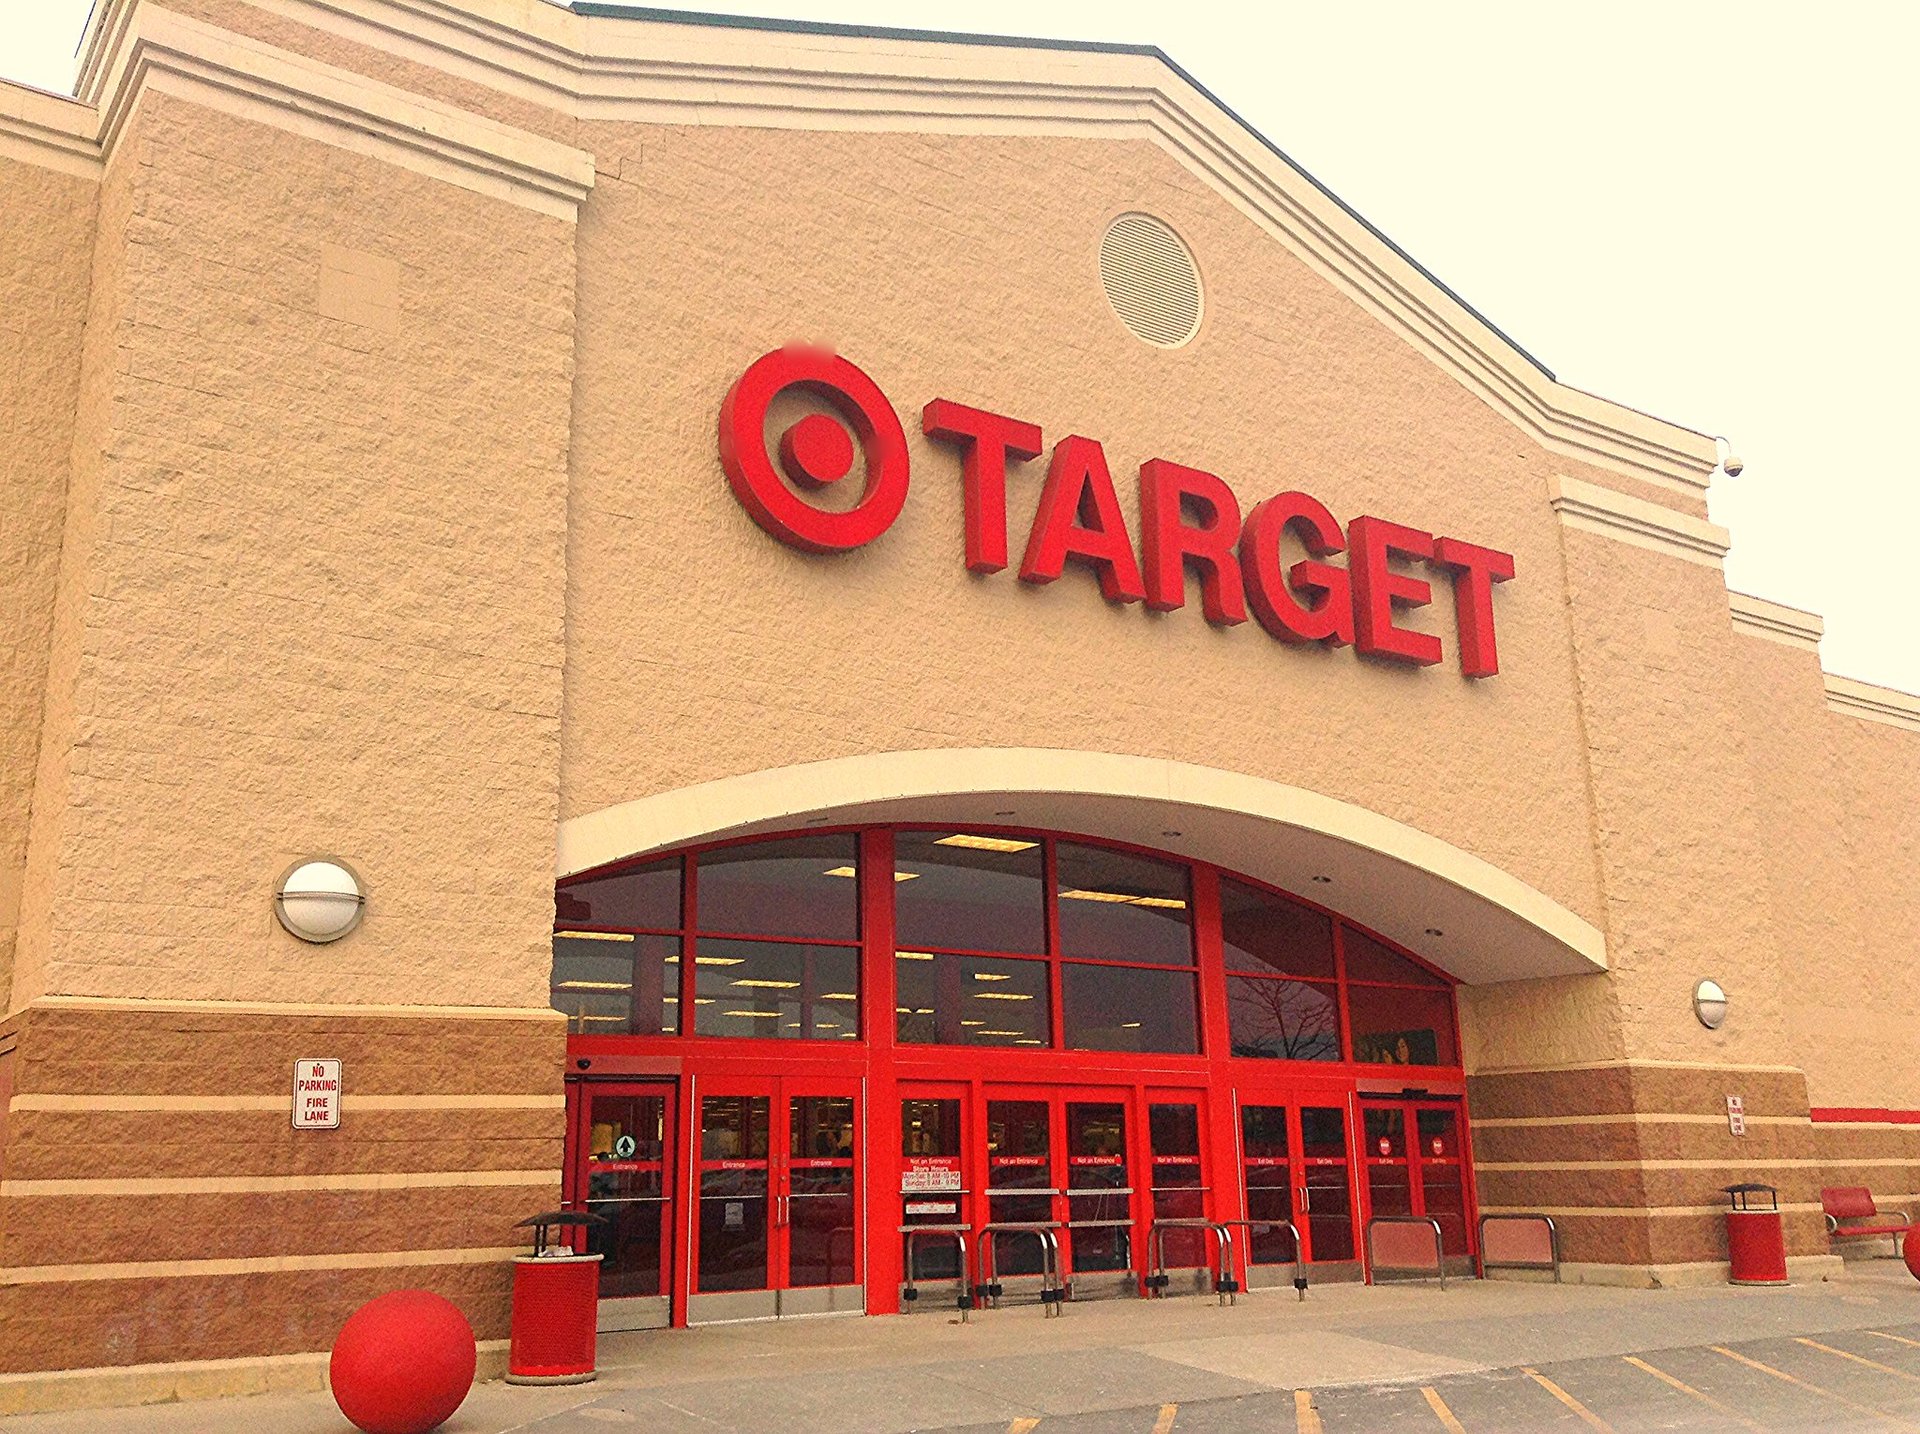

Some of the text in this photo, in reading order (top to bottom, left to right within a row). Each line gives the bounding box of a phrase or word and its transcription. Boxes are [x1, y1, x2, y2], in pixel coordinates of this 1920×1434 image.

[923, 398, 1514, 678] TARGET
[312, 1066, 324, 1077] NO
[299, 1080, 337, 1091] PARKING
[306, 1098, 328, 1108] FIRE
[304, 1111, 329, 1121] LANE
